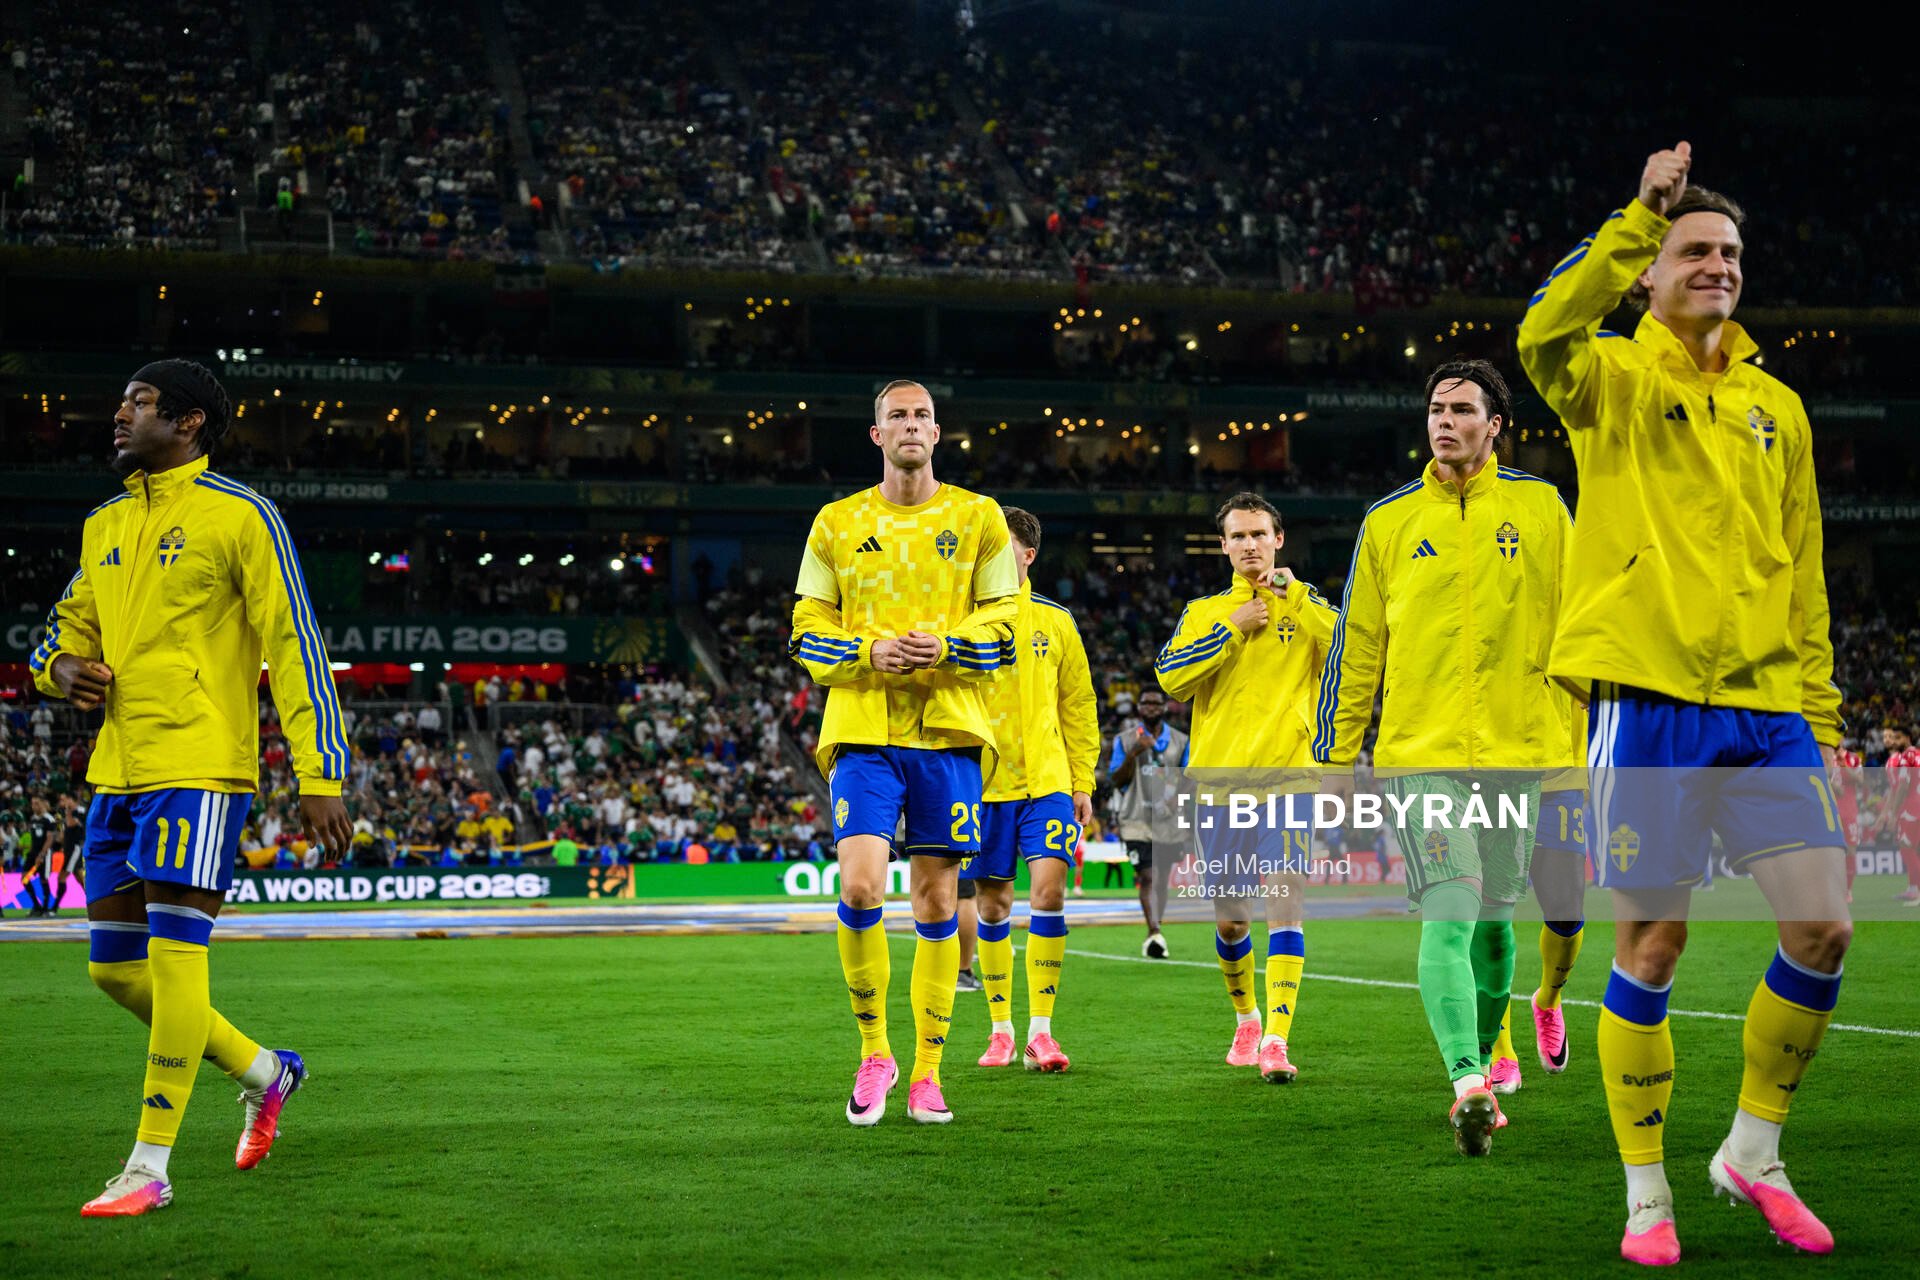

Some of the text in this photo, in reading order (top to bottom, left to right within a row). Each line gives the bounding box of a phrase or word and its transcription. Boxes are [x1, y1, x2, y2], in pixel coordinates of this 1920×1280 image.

[224, 364, 405, 381] MONTERREY
[286, 483, 321, 498] CUP
[324, 483, 389, 499] 2026
[325, 626, 568, 652] LA FIFA 2026
[1045, 820, 1077, 857] 22
[1558, 805, 1585, 844] 13
[156, 817, 190, 869] 11
[263, 876, 373, 902] WORLD
[376, 875, 436, 902] CUP
[439, 872, 541, 899] 2026
